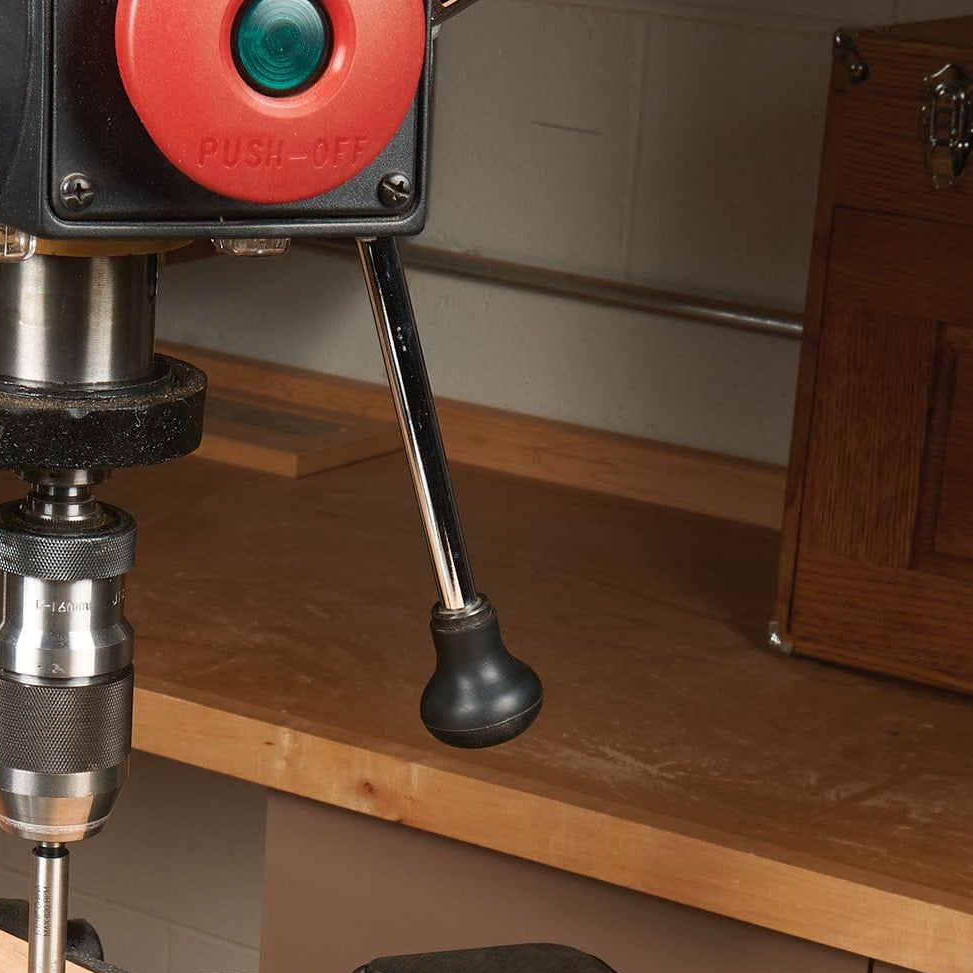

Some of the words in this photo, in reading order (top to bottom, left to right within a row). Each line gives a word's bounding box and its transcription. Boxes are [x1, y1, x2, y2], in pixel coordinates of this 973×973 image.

[198, 135, 370, 170] PUSH-OFF
[43, 886, 51, 904] RPM
[43, 919, 51, 937] MAX
